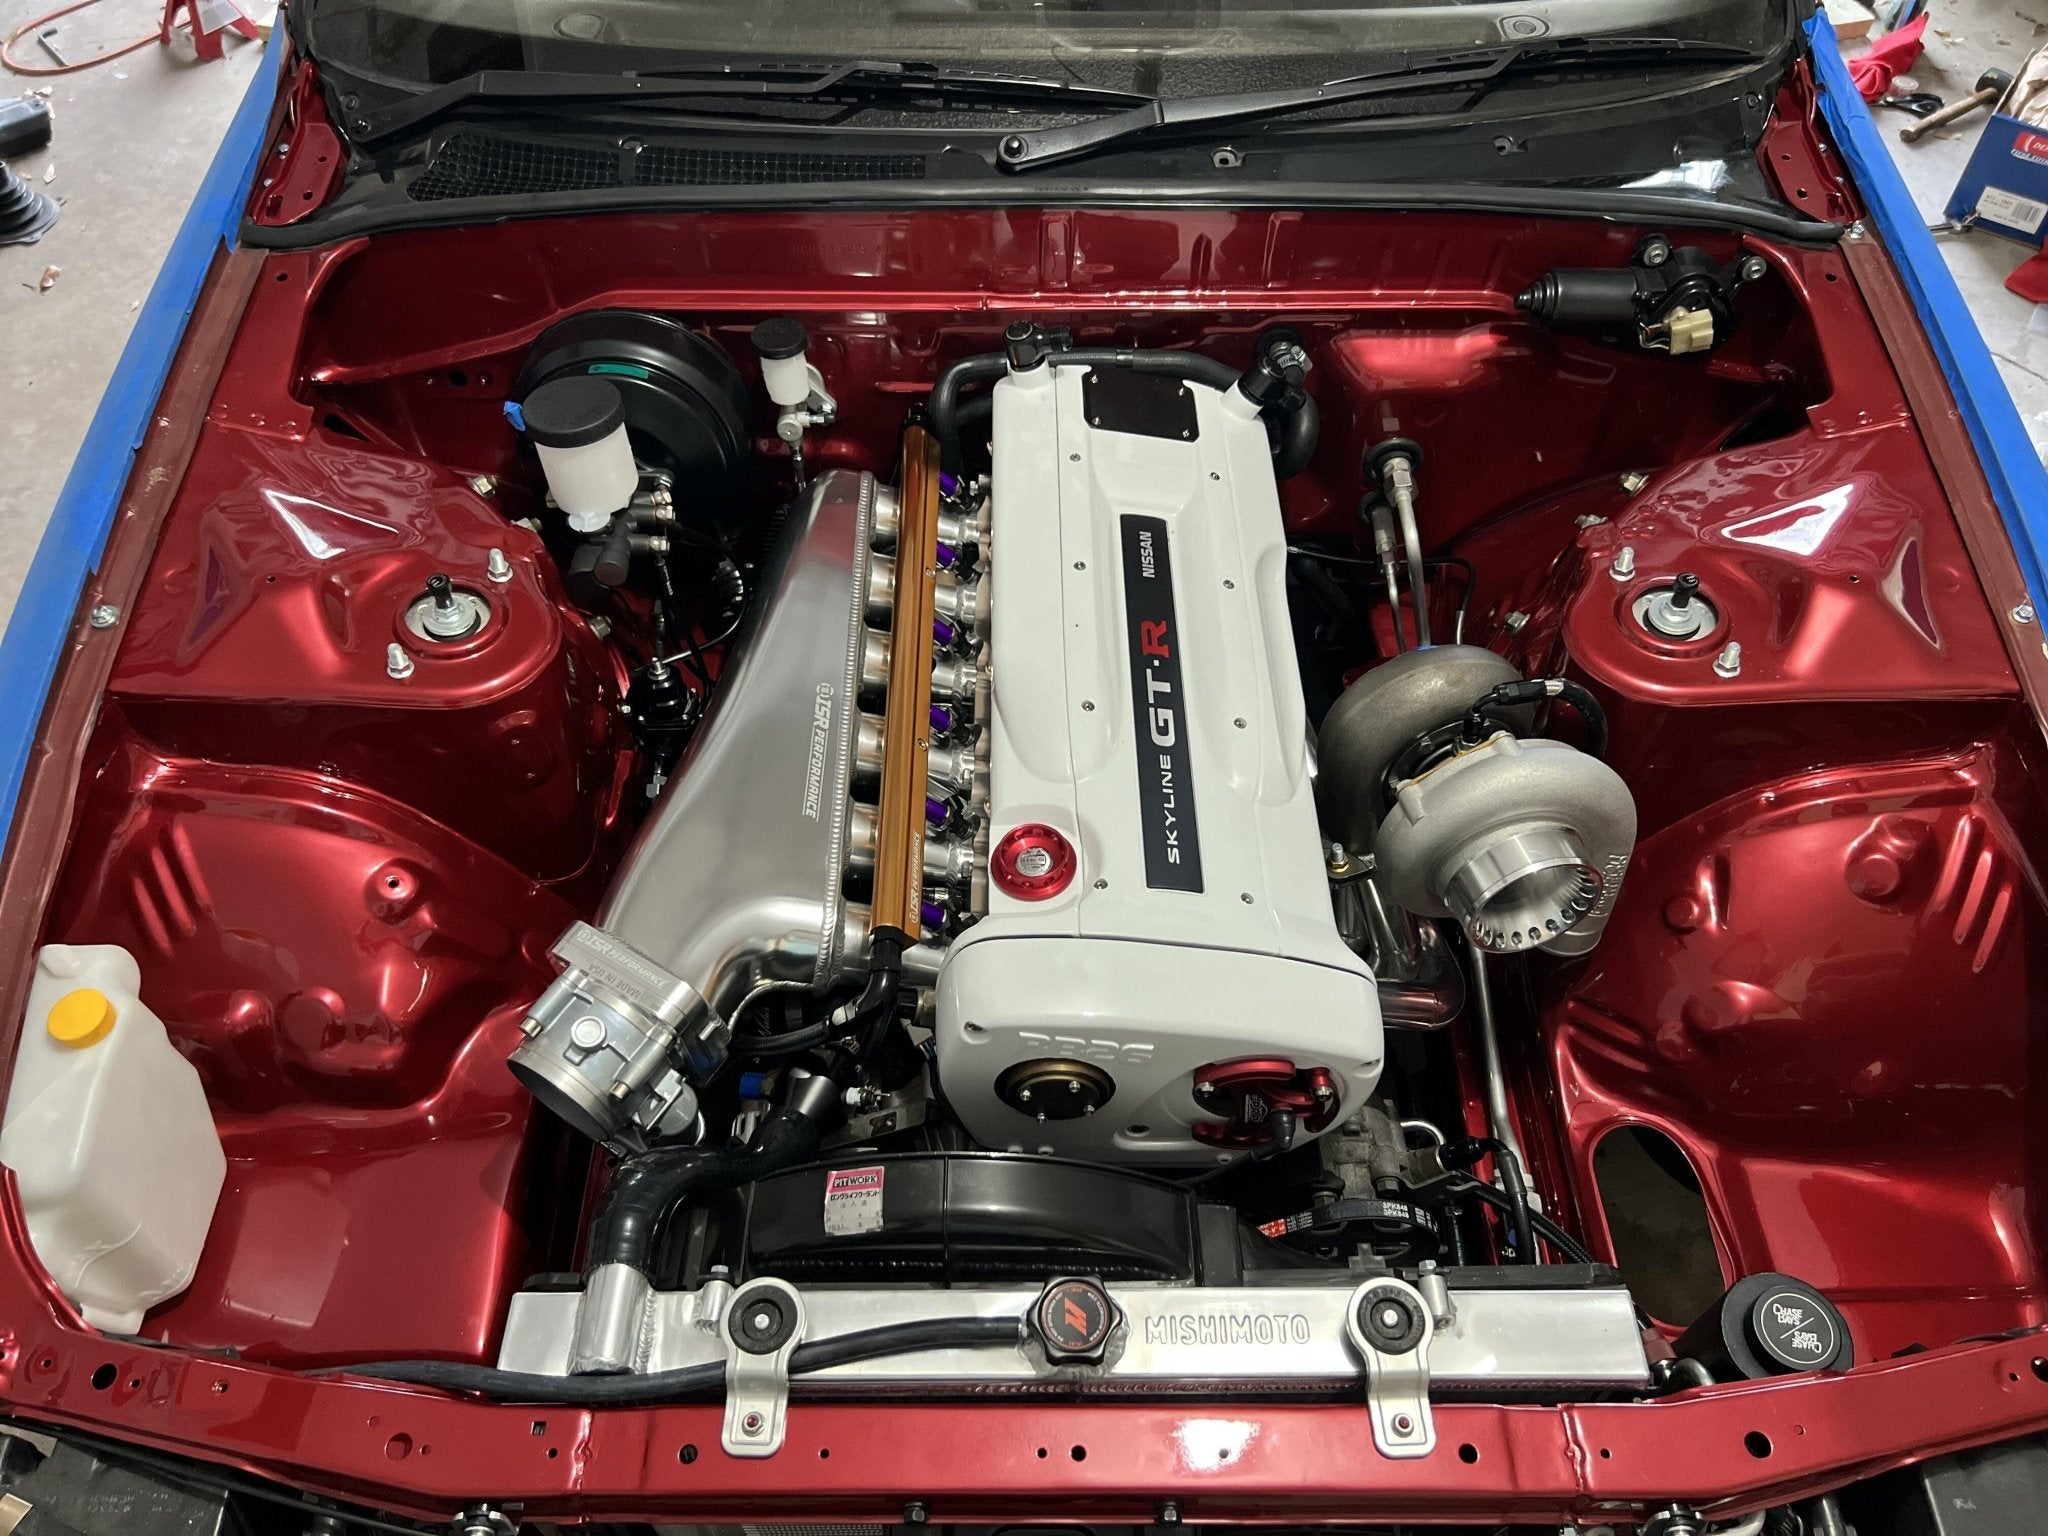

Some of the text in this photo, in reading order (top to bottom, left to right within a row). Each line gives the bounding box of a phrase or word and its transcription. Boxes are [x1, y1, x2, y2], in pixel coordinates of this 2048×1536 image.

[1139, 531, 1155, 578] NISSAN
[805, 728, 826, 819] PERFORMANCE
[1159, 754, 1180, 864] SKYLINE
[589, 962, 642, 999] MADE IN USA
[609, 949, 668, 987] PERFORMANCE
[1018, 1031, 1154, 1063] RB26
[1145, 1314, 1310, 1345] MISHIMOTO
[1778, 1312, 1800, 1325] BAYS
[1794, 1331, 1817, 1343] BAYS
